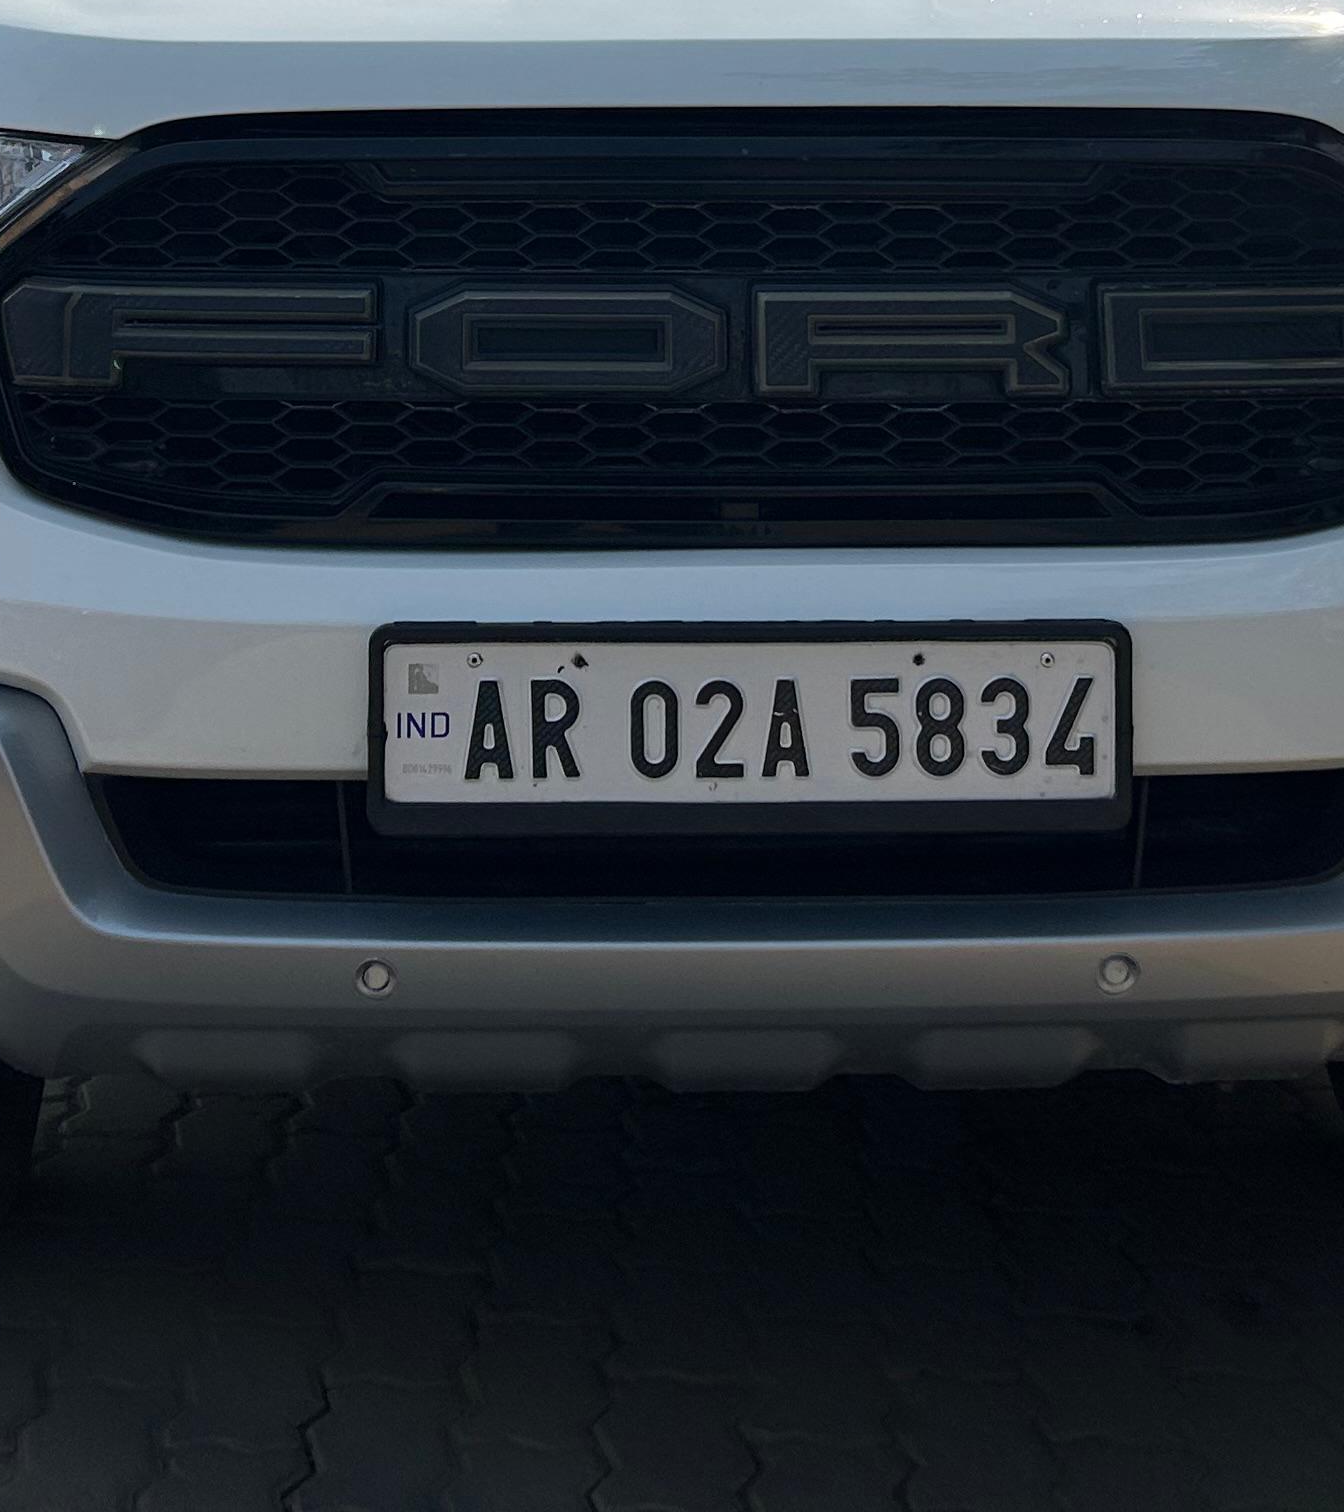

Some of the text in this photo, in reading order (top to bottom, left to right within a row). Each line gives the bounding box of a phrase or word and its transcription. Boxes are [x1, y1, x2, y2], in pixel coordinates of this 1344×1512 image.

[396, 711, 451, 739] IND
[463, 676, 1097, 781] AR 02A 5834
